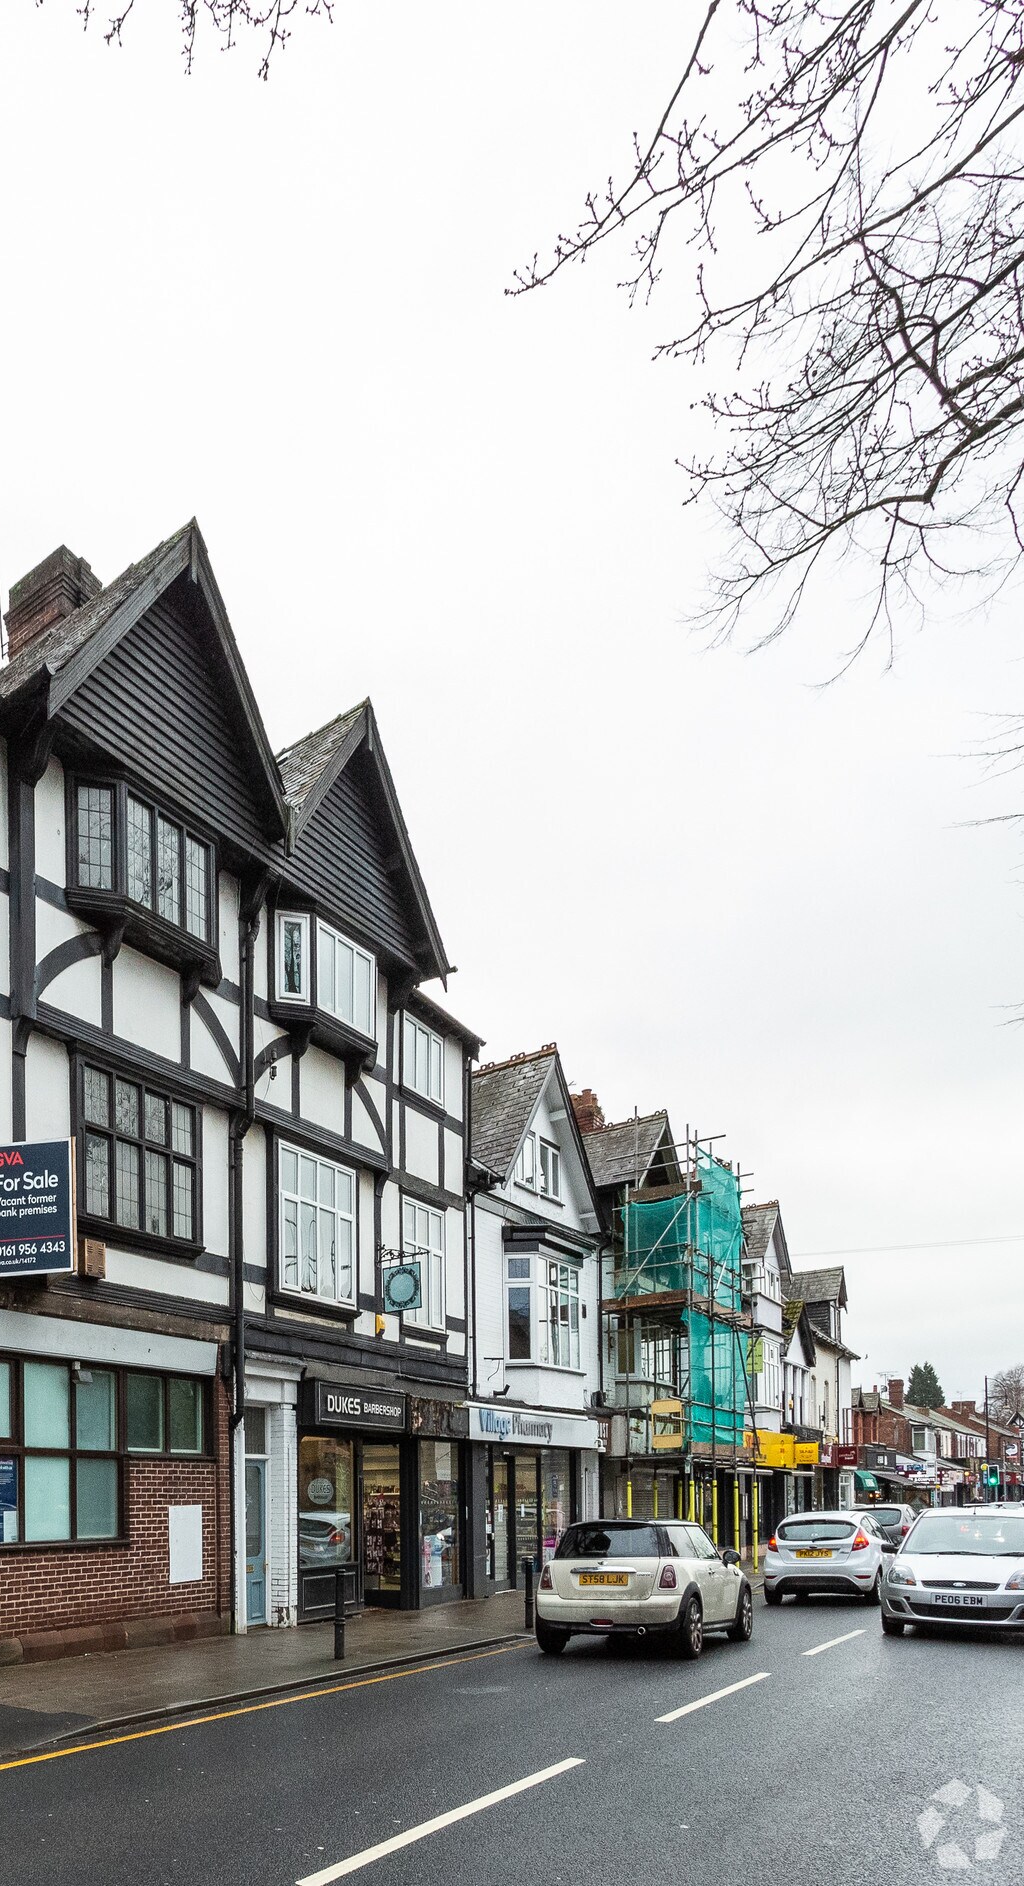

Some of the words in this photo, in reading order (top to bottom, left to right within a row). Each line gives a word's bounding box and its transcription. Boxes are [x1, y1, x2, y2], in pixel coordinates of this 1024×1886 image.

[23, 1170, 59, 1190] Sale
[28, 1194, 57, 1204] former
[19, 1204, 58, 1218] premises
[18, 1243, 37, 1255] 956
[40, 1241, 65, 1254] 4343
[327, 1394, 361, 1415] DUKES
[363, 1402, 402, 1417] BARBERSHOP
[478, 1408, 511, 1441] Village
[512, 1413, 553, 1444] Pharmacy
[582, 1574, 605, 1584] ST58
[607, 1574, 624, 1584] LJK
[935, 1595, 961, 1604] PE06
[963, 1596, 983, 1606] EBM
